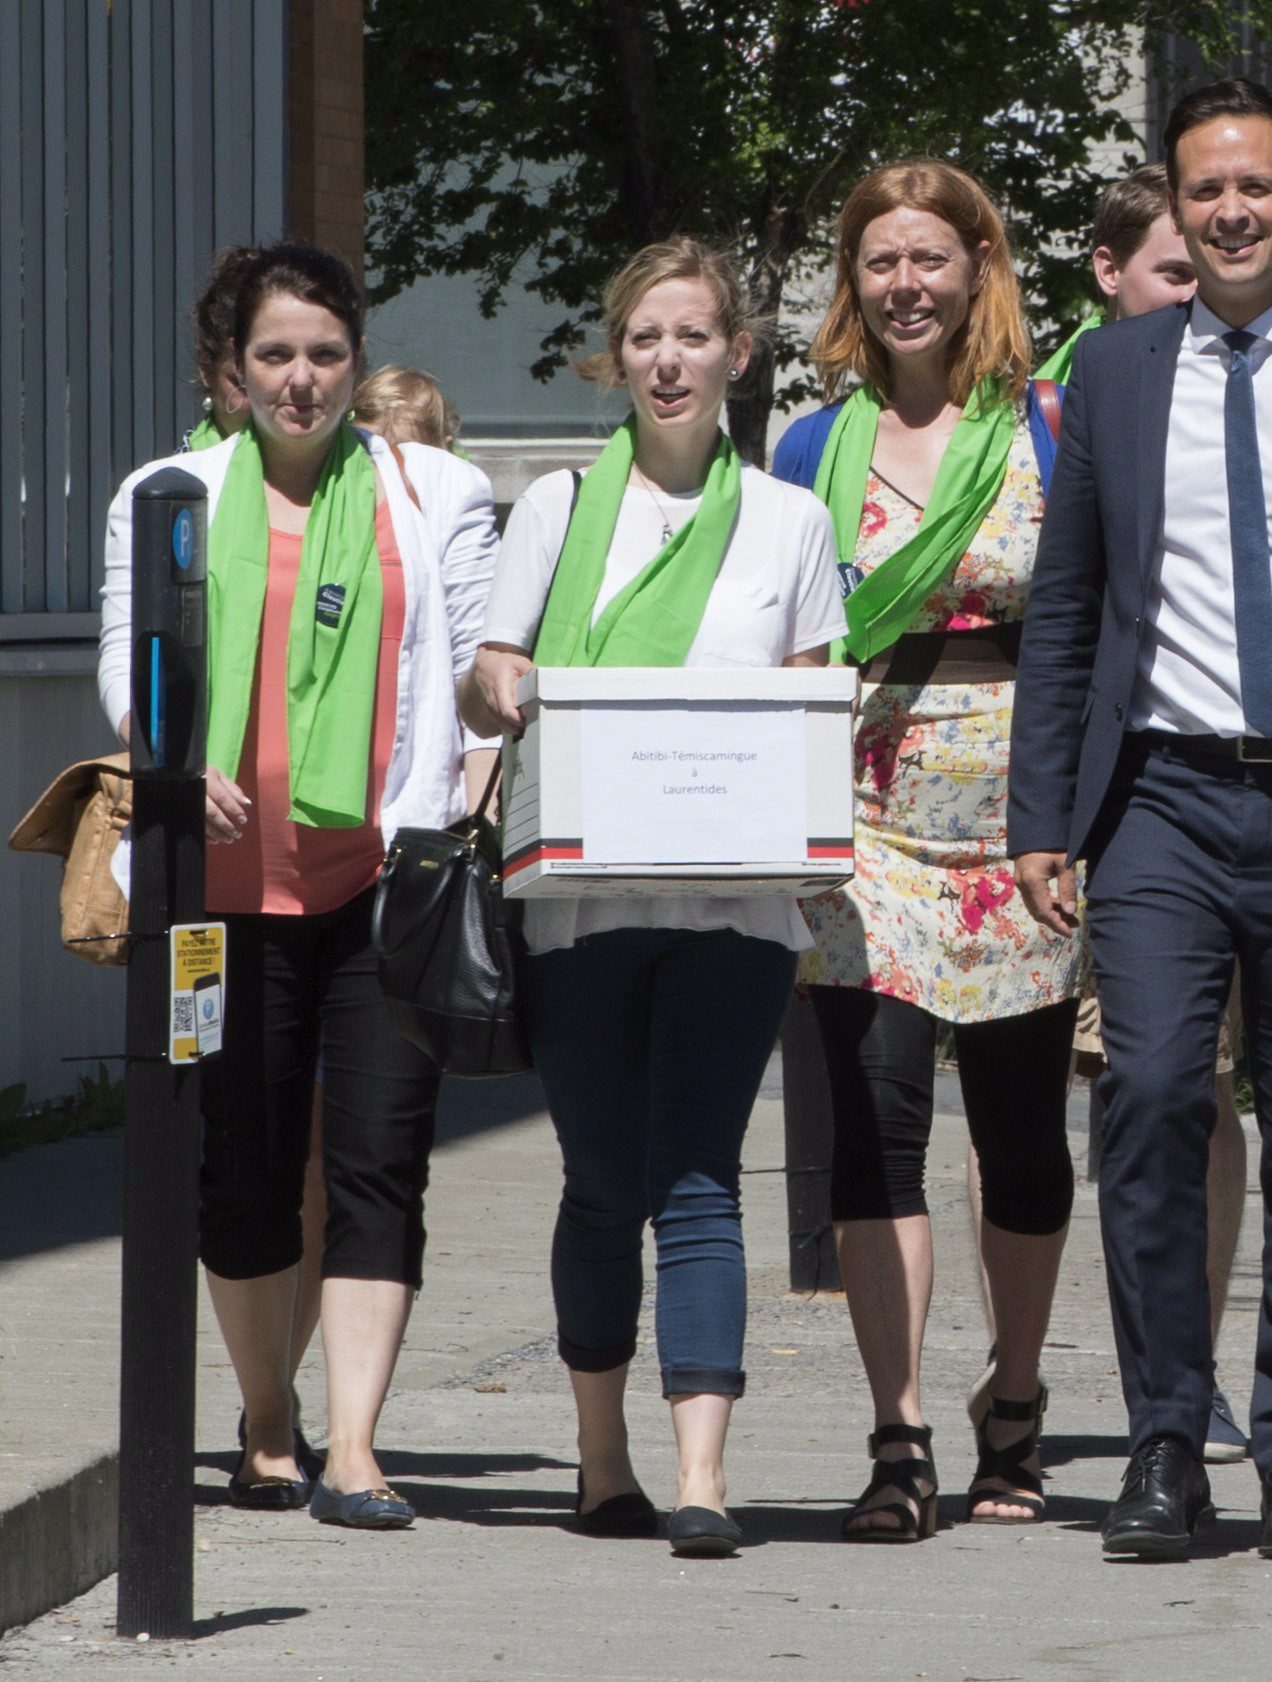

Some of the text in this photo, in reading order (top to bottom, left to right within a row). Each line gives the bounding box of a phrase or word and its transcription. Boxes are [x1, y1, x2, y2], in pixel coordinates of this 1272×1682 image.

[631, 750, 758, 763] Abitibi-Témiscamingue
[690, 767, 698, 777] à
[662, 784, 728, 795] Laurentides
